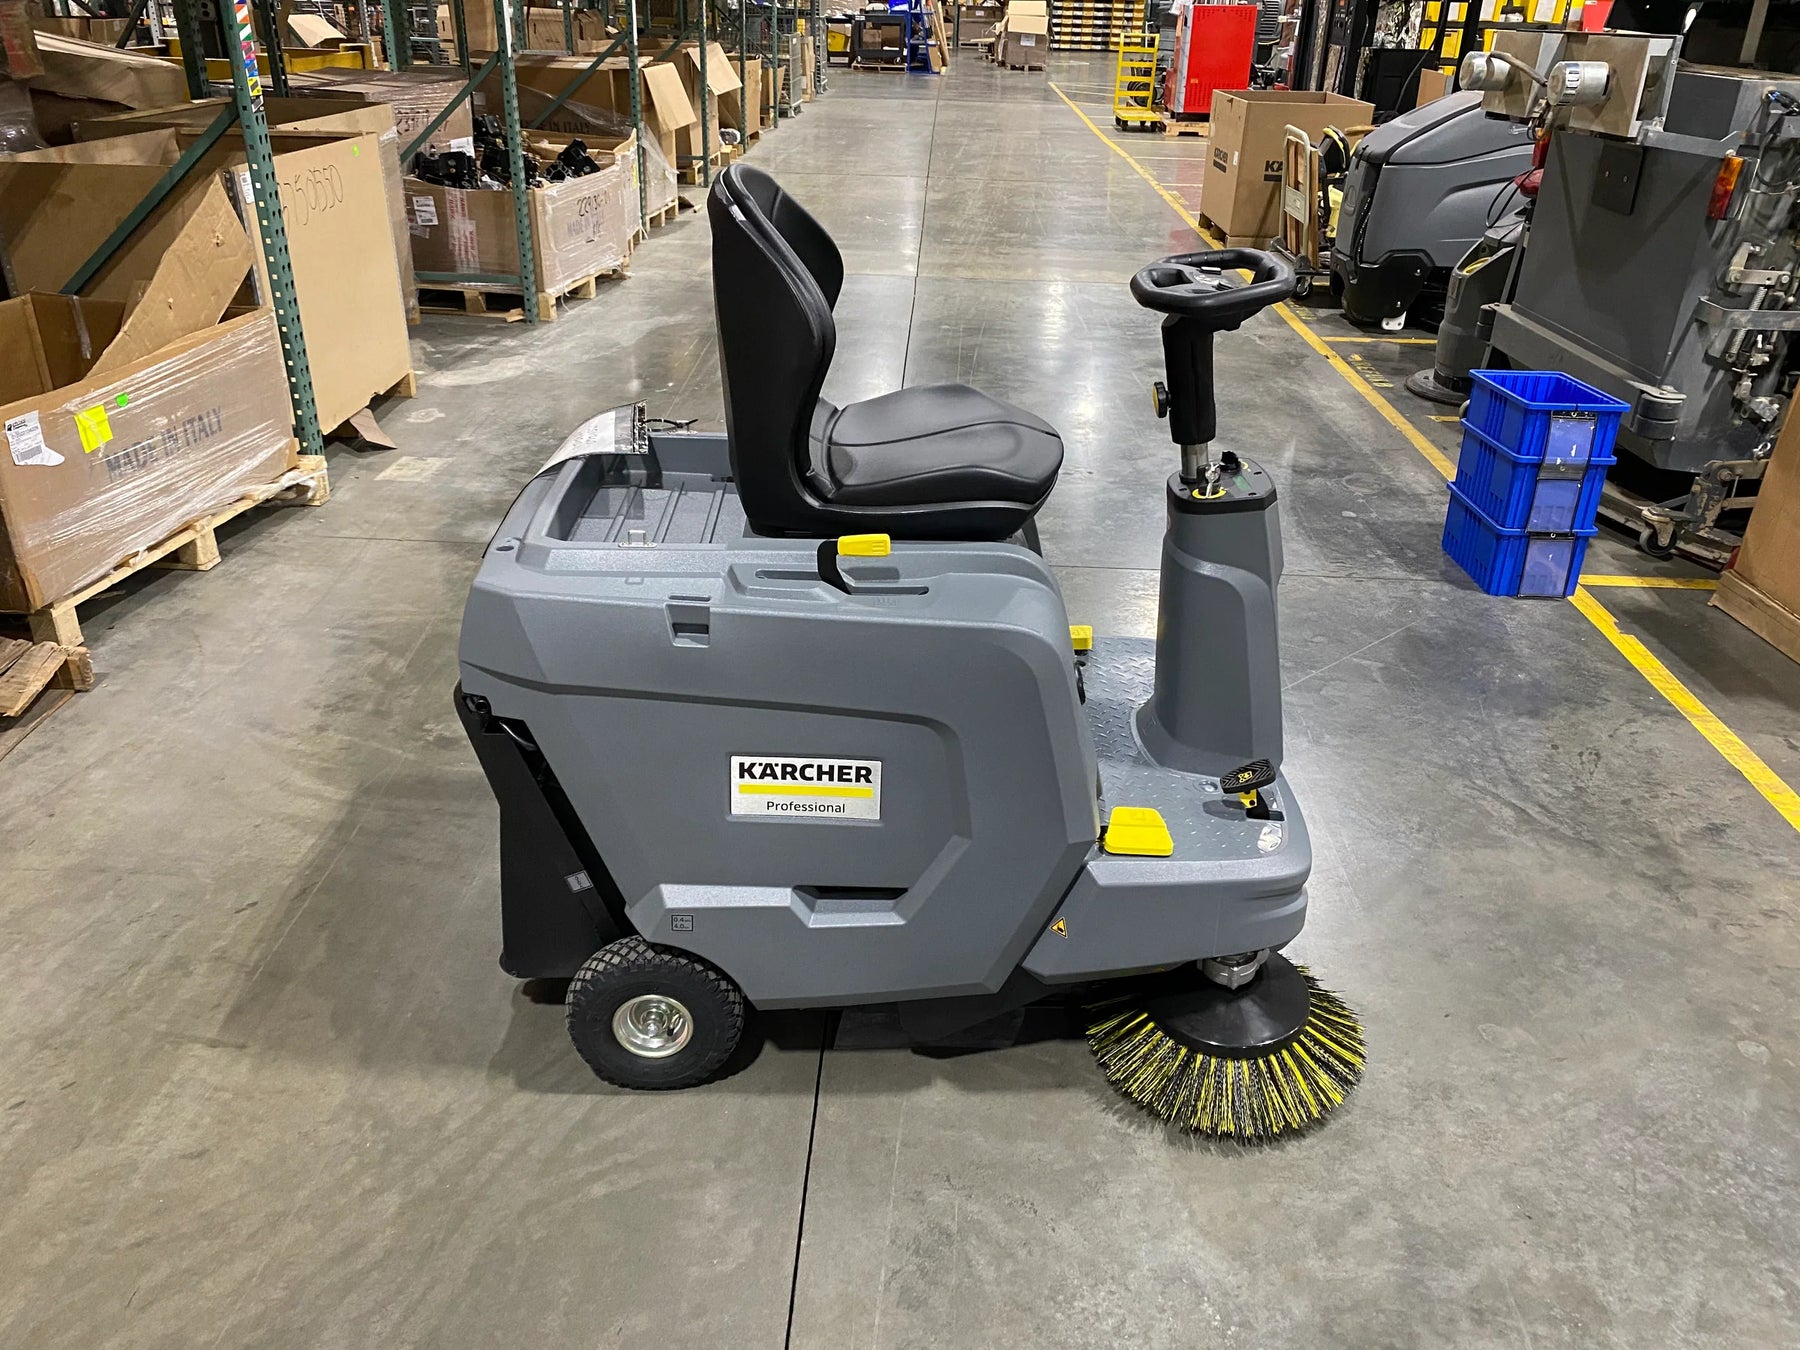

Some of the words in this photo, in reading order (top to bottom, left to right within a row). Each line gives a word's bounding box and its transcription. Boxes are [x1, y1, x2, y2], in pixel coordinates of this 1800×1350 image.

[105, 436, 159, 483] MADE
[160, 426, 181, 458] IN
[182, 406, 223, 447] ITALY
[738, 762, 873, 783] KÄRCHER
[766, 801, 846, 813] Professional
